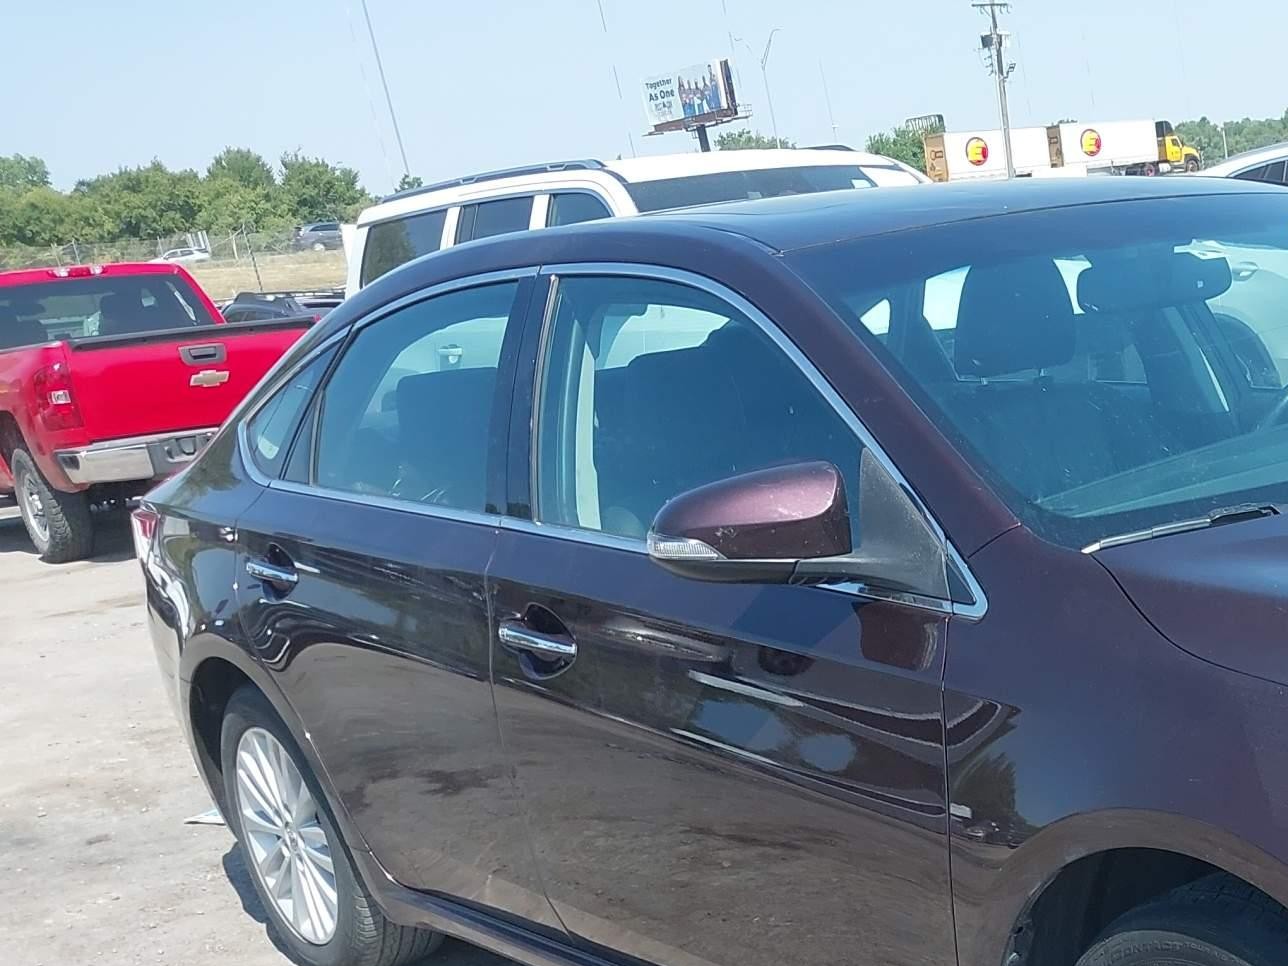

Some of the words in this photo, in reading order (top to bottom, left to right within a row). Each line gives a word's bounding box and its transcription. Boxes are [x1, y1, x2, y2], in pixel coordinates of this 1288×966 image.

[645, 78, 672, 89] Together
[649, 92, 658, 102] As
[659, 89, 675, 99] One
